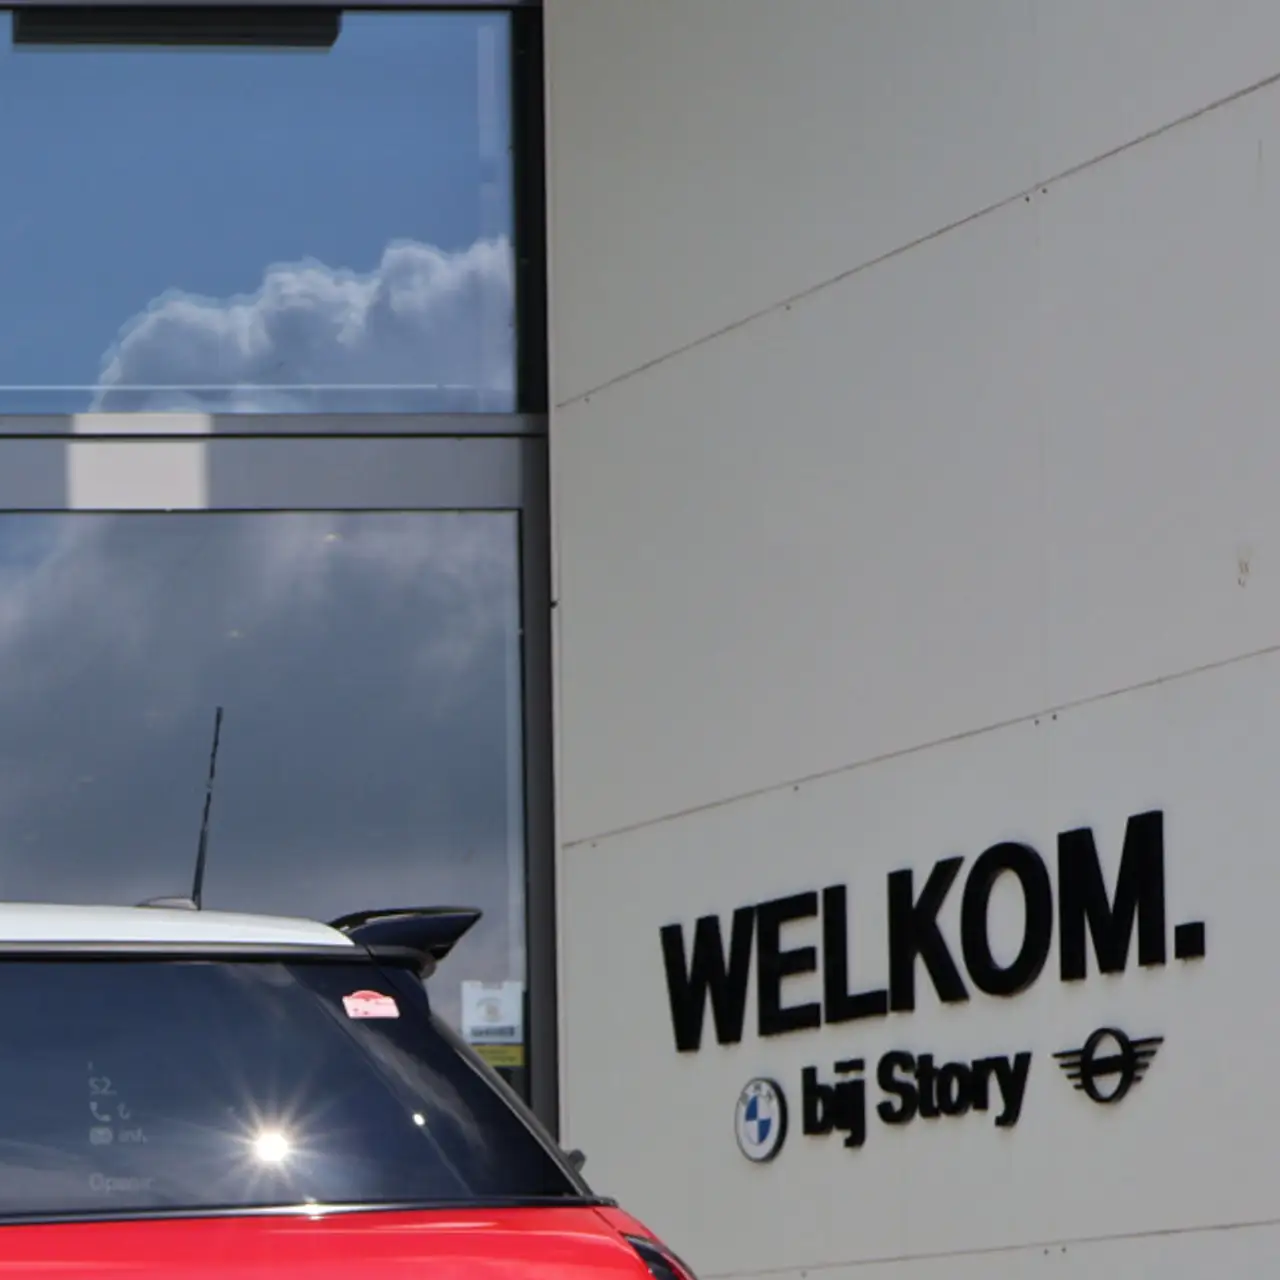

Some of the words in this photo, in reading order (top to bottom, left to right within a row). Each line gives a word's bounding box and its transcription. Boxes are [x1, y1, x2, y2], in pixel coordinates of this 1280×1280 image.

[660, 809, 1205, 1053] WELKOM.
[801, 1058, 866, 1148] bij
[876, 1049, 1033, 1128] Story
